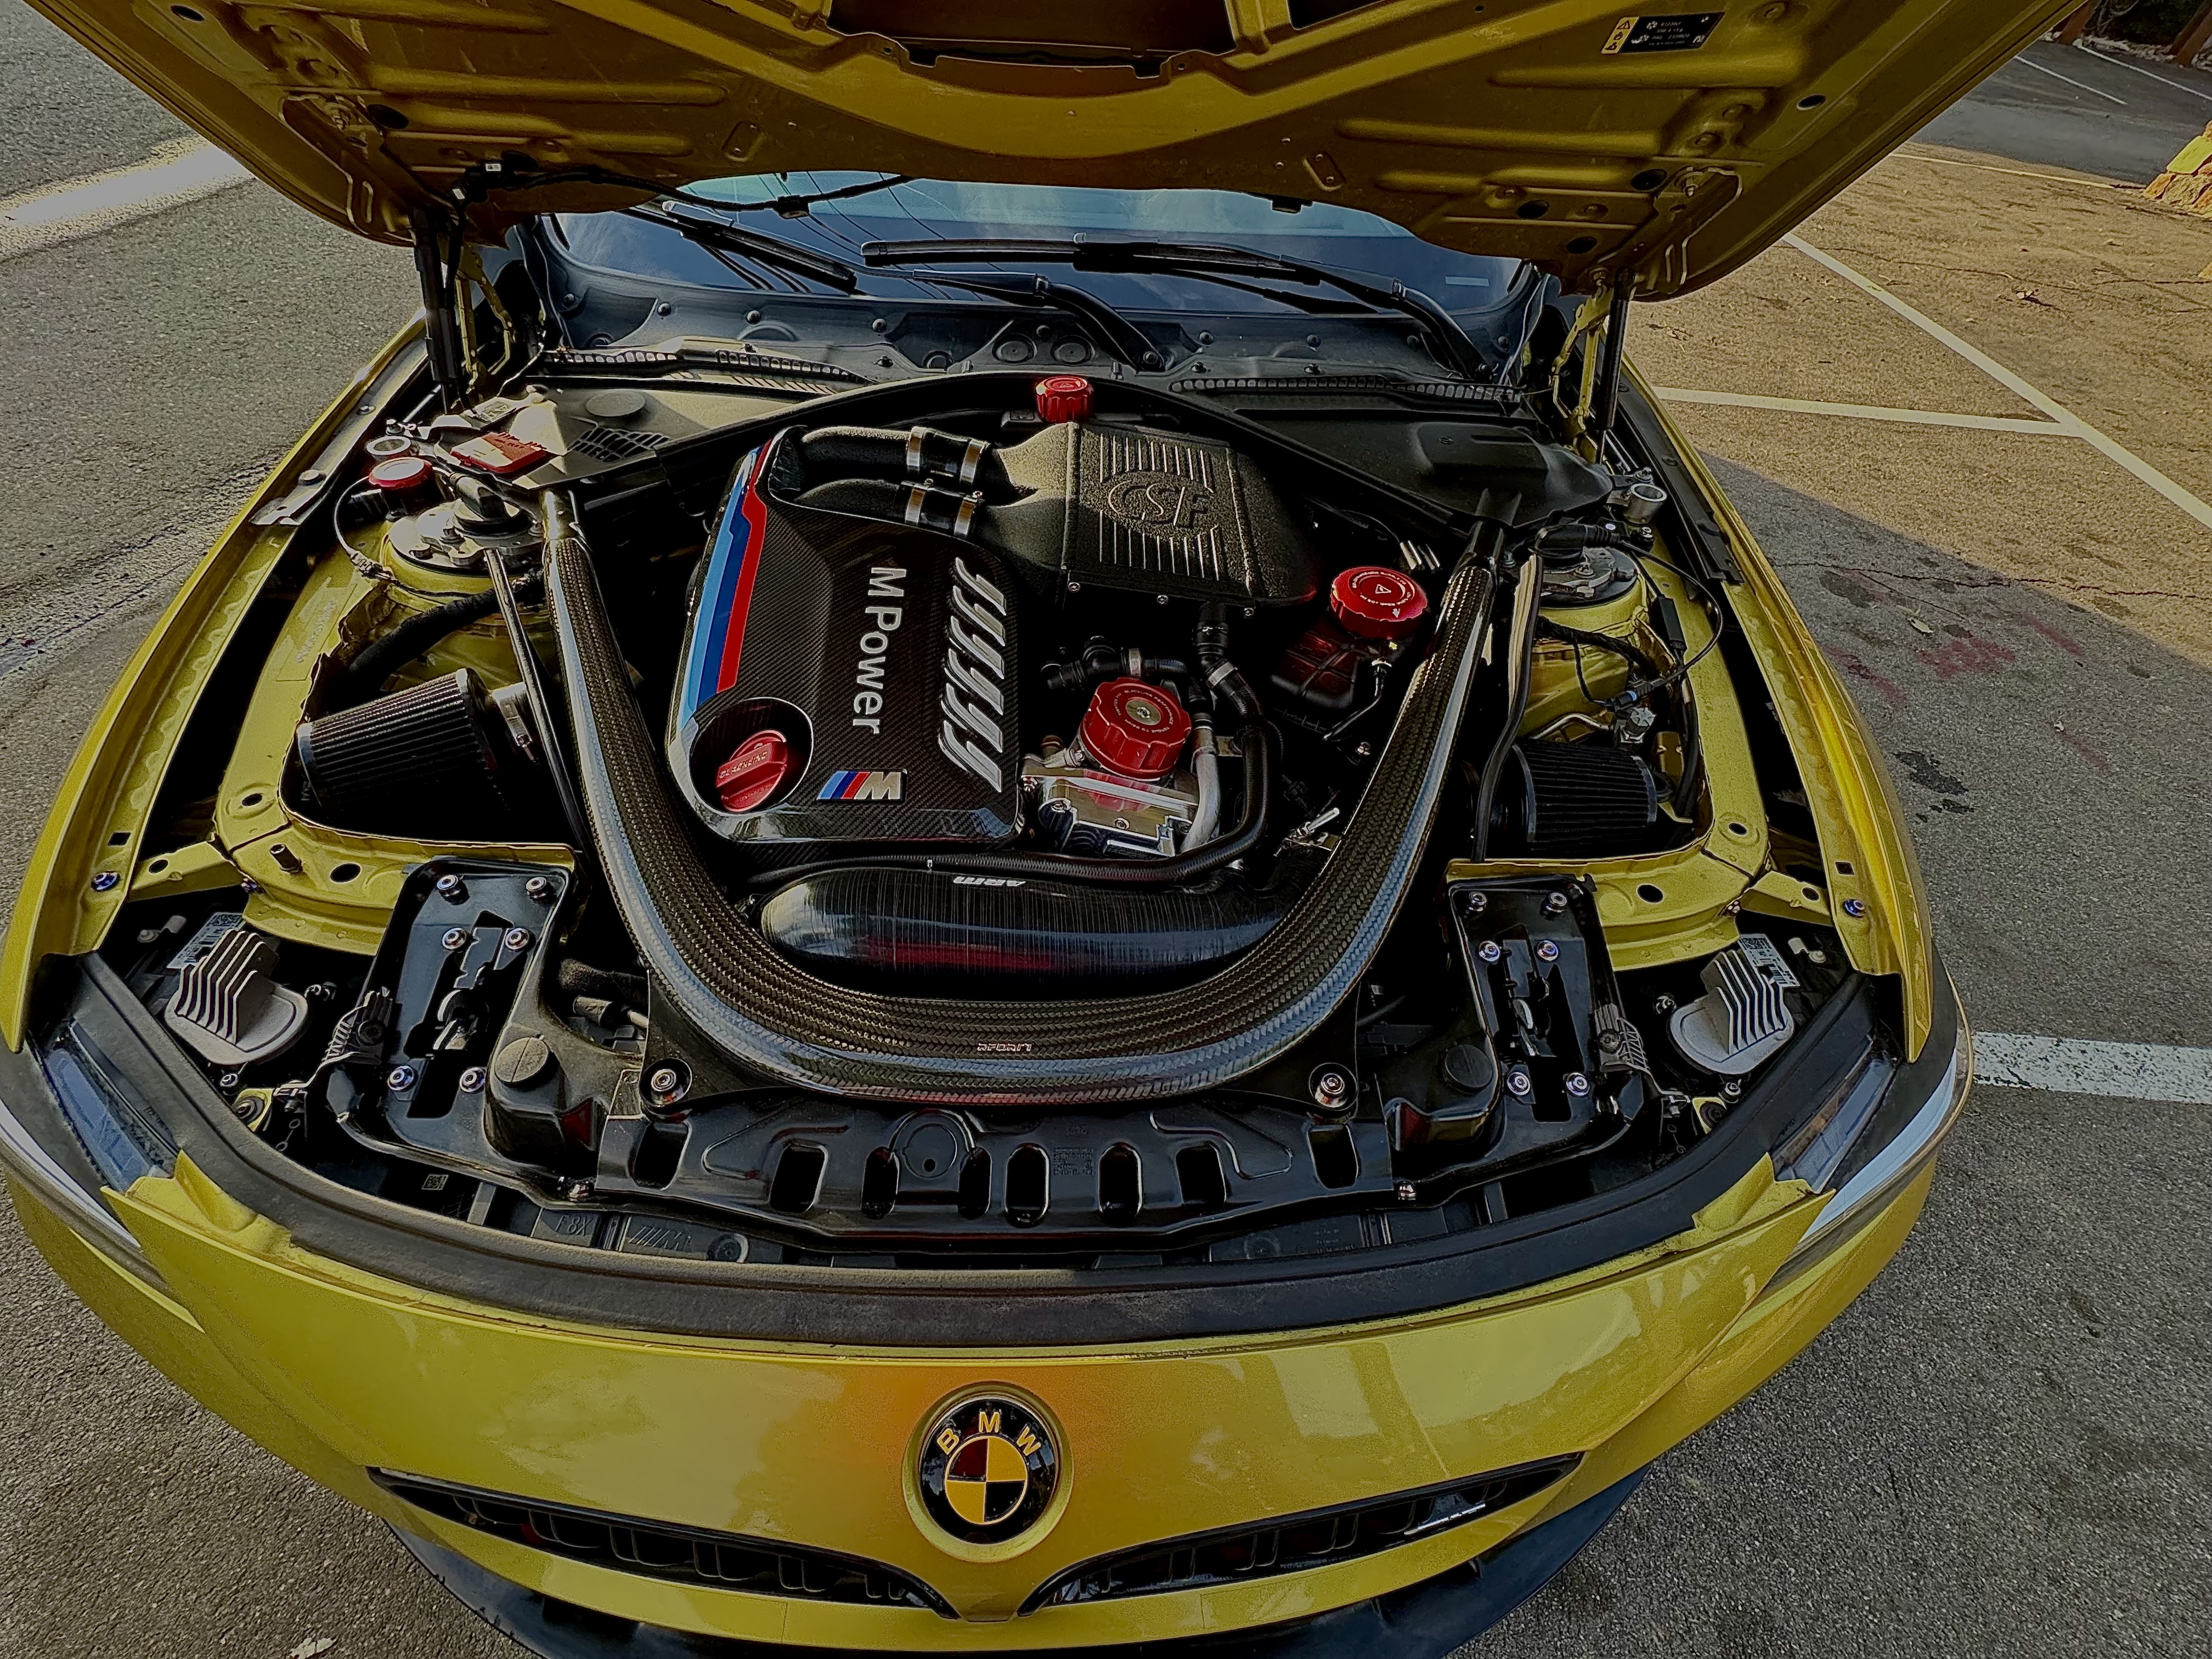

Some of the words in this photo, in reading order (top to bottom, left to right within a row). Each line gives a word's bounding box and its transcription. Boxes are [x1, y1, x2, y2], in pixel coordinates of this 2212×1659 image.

[1108, 480, 1211, 528] CSF
[868, 567, 907, 597] M
[852, 606, 903, 735] Power
[936, 1410, 1041, 1457] BMW
